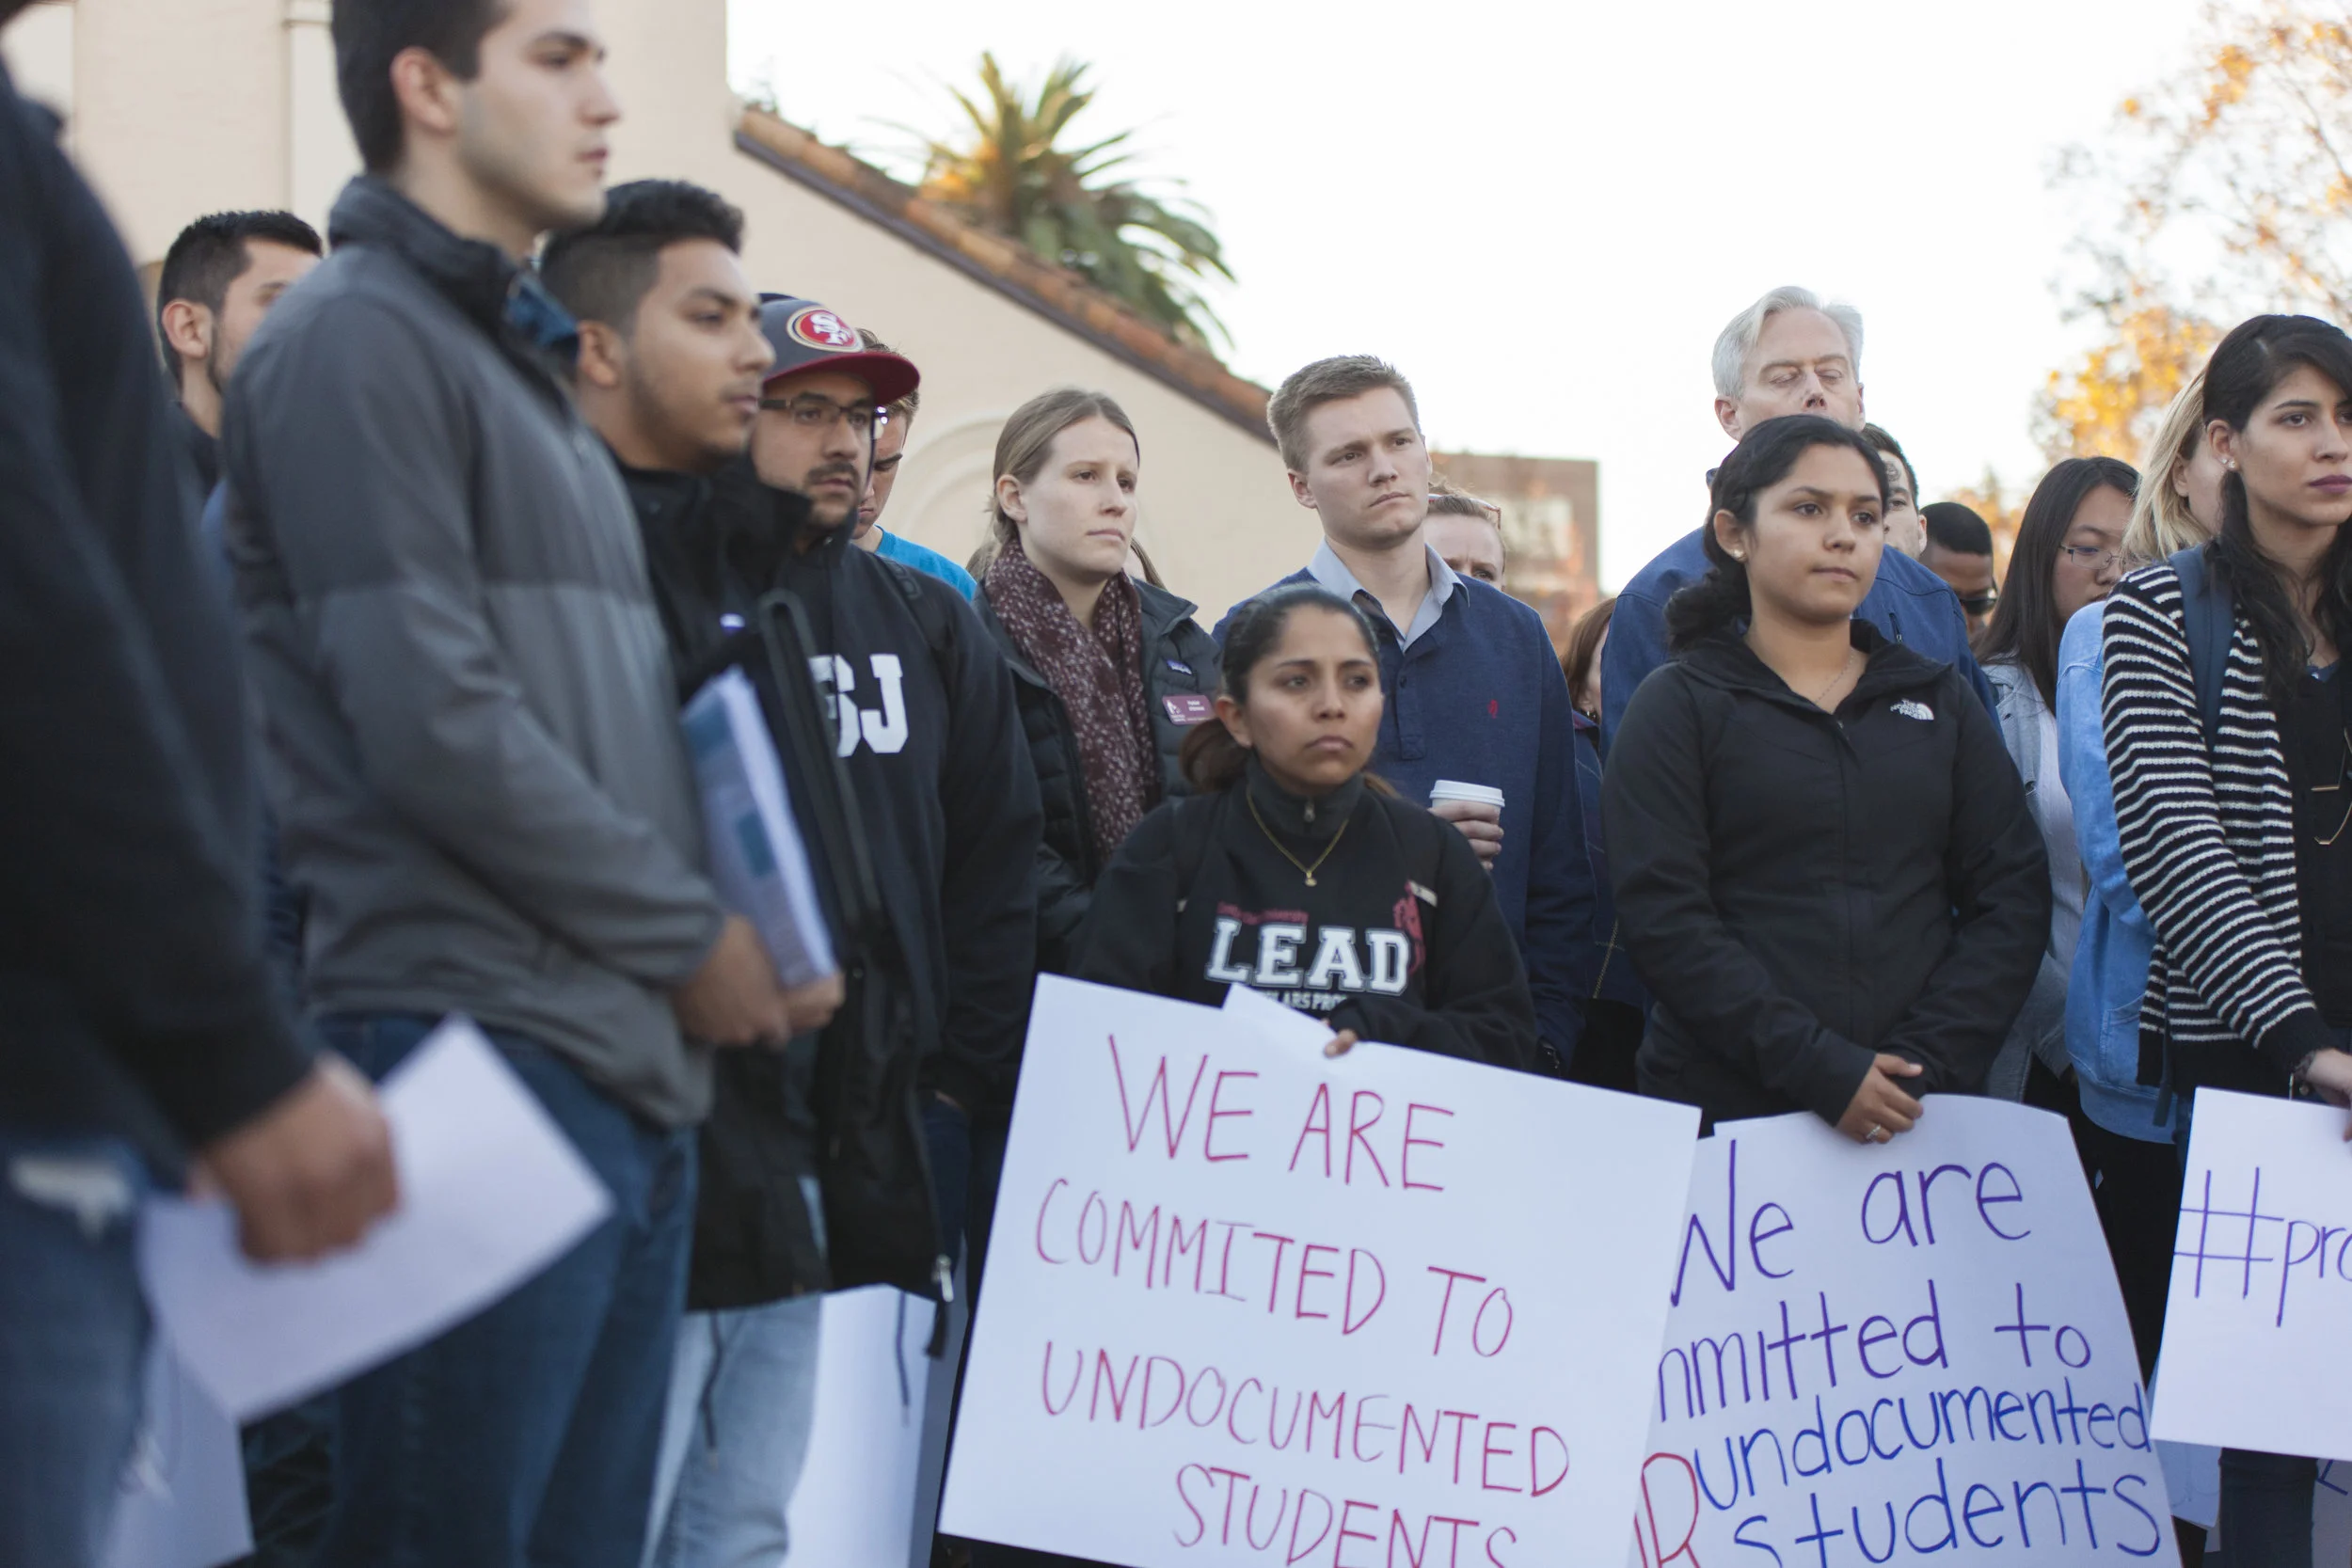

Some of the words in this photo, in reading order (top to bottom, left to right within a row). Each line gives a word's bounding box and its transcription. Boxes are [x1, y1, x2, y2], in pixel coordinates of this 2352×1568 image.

[1204, 915, 1410, 996] LEAD
[1108, 1034, 1260, 1163] WE
[1288, 1082, 1455, 1192] ARE
[1862, 1162, 2032, 1248] are
[1036, 1178, 1387, 1337] COMMITED
[1428, 1266, 1513, 1356] TO
[1994, 1282, 2091, 1370] to
[1041, 1339, 1569, 1497] UNDOCUMENTED
[1694, 1376, 2153, 1511] undocumented
[1173, 1463, 1517, 1568] STUDENTS
[1733, 1456, 2161, 1568] students
